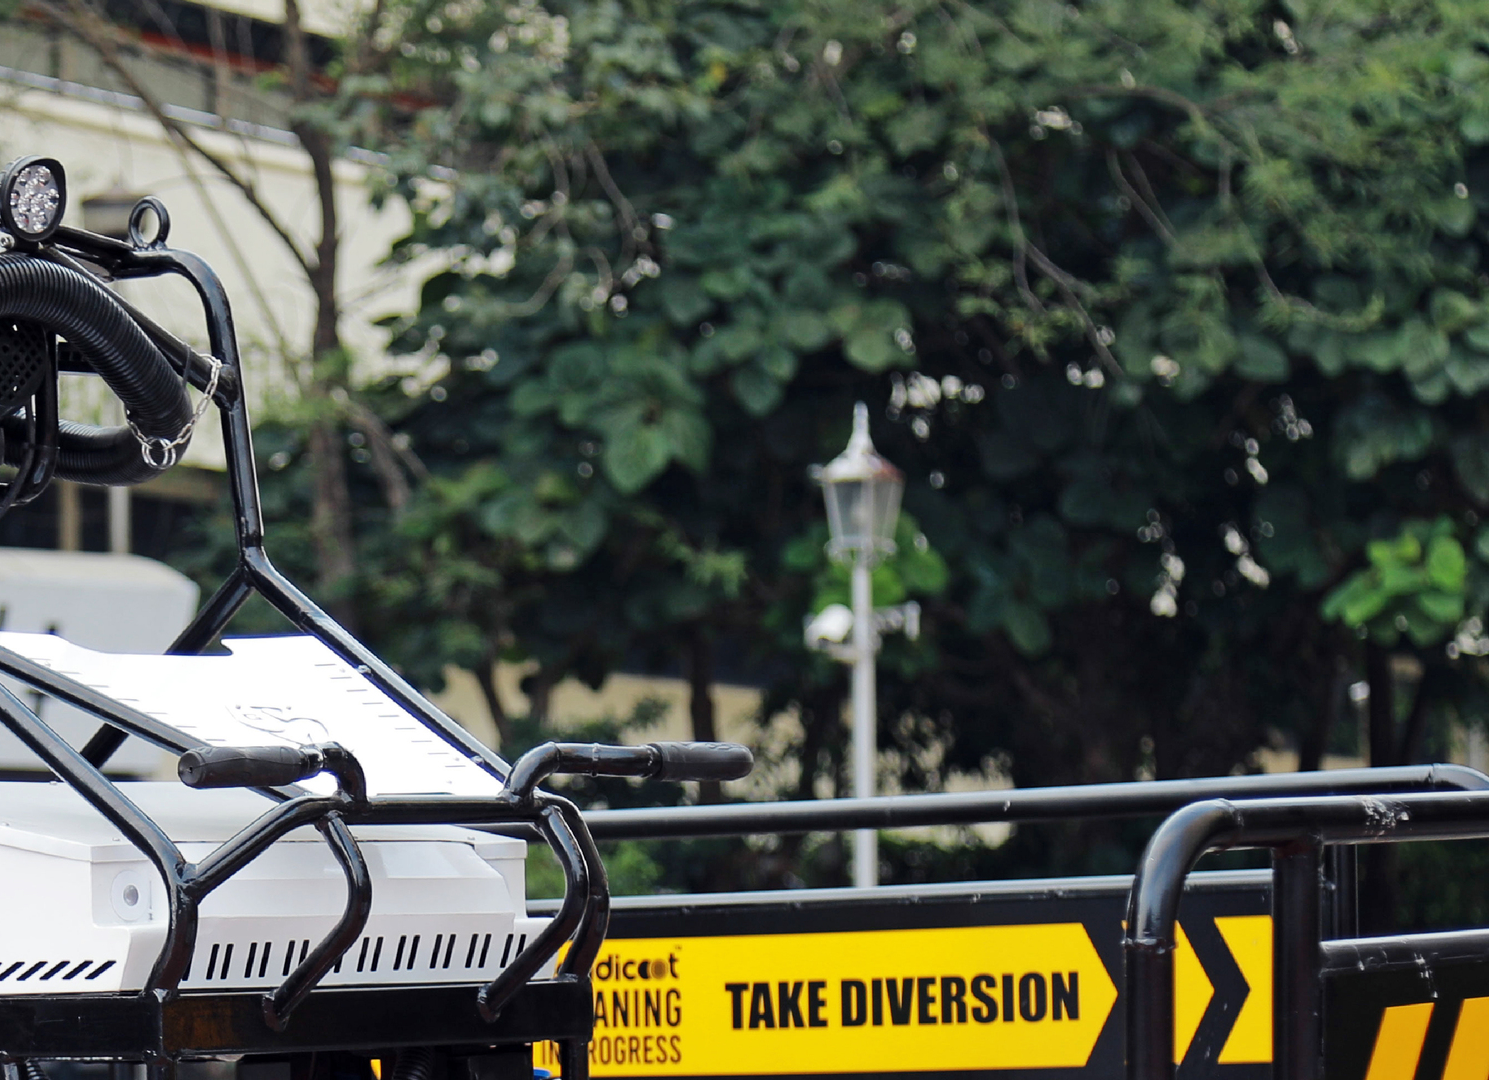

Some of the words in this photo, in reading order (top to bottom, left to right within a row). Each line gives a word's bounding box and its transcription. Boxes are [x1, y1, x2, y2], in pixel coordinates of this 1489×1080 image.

[593, 988, 682, 1028] ANING
[725, 980, 828, 1030] TAKE
[840, 971, 1080, 1027] DIVERSION
[589, 1034, 682, 1064] ROGRESS
